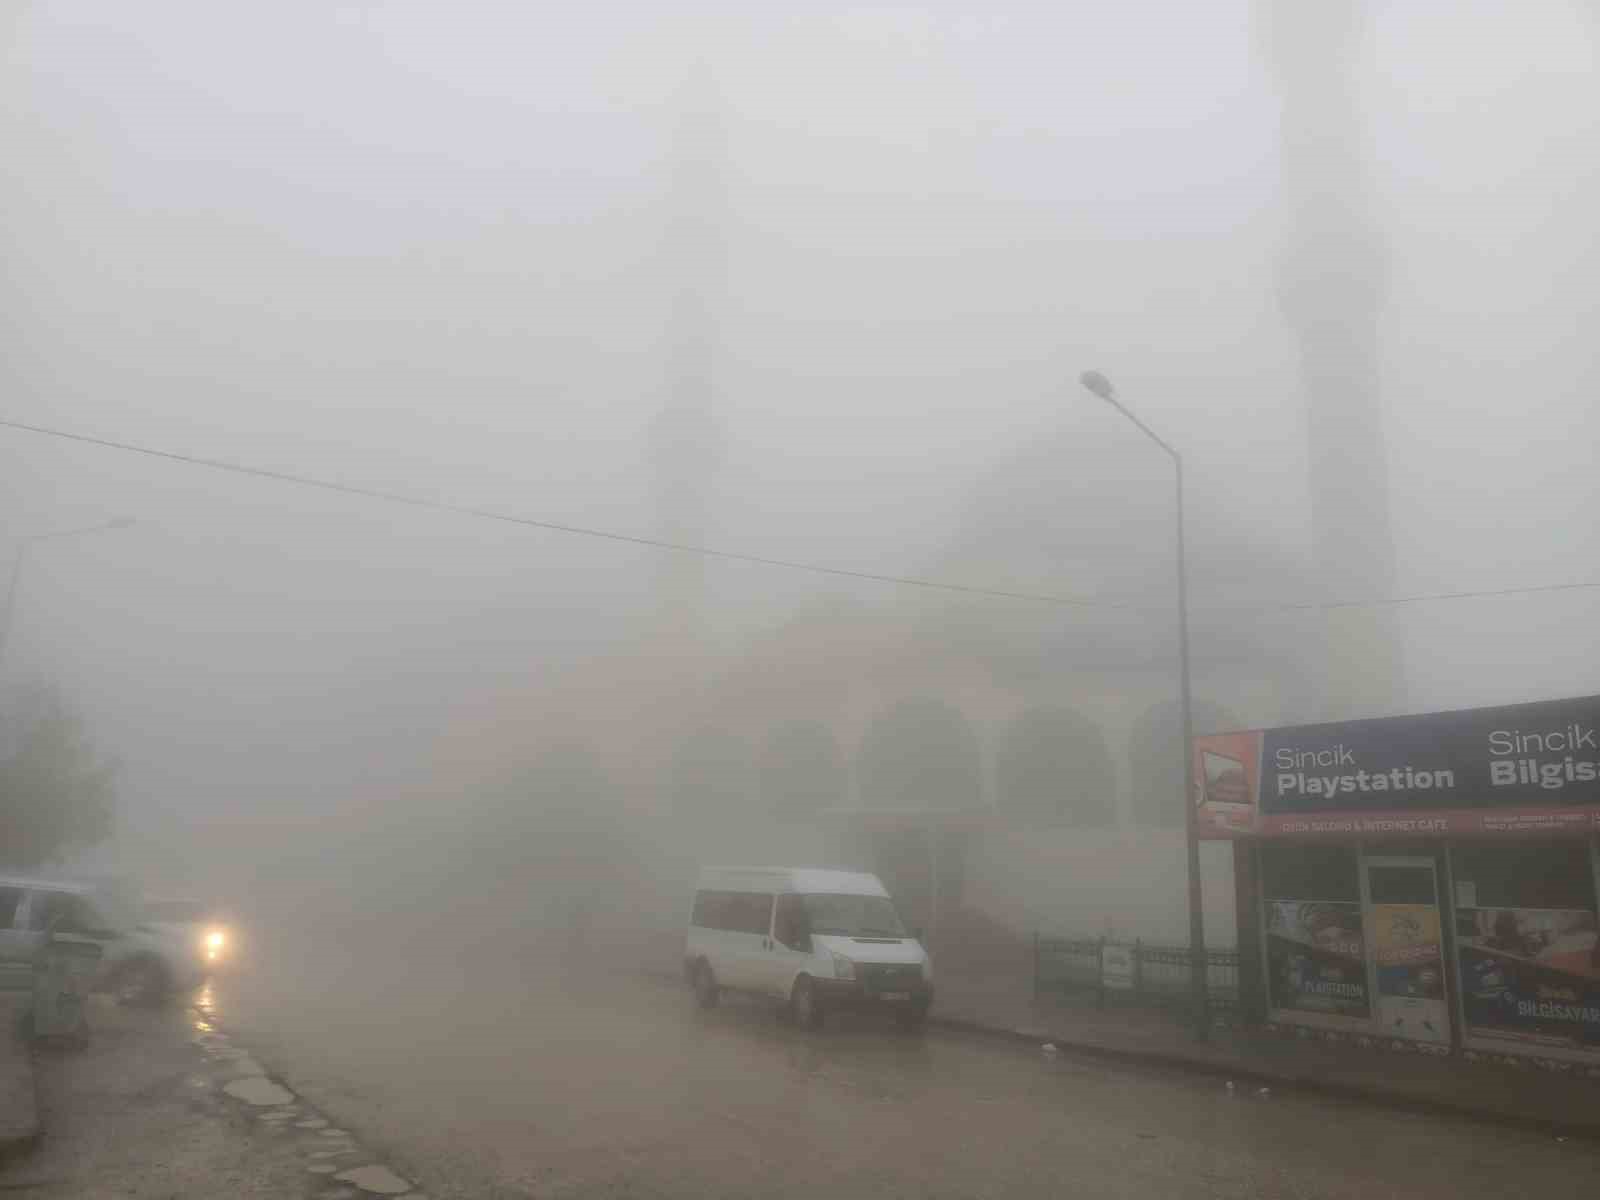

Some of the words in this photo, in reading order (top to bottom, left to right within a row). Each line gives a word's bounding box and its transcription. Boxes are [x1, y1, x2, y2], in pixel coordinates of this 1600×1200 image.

[1488, 723, 1597, 756] Sincik
[1275, 744, 1356, 770] Sincik
[1490, 757, 1600, 789] Bilgis
[1277, 766, 1455, 799] Playstation
